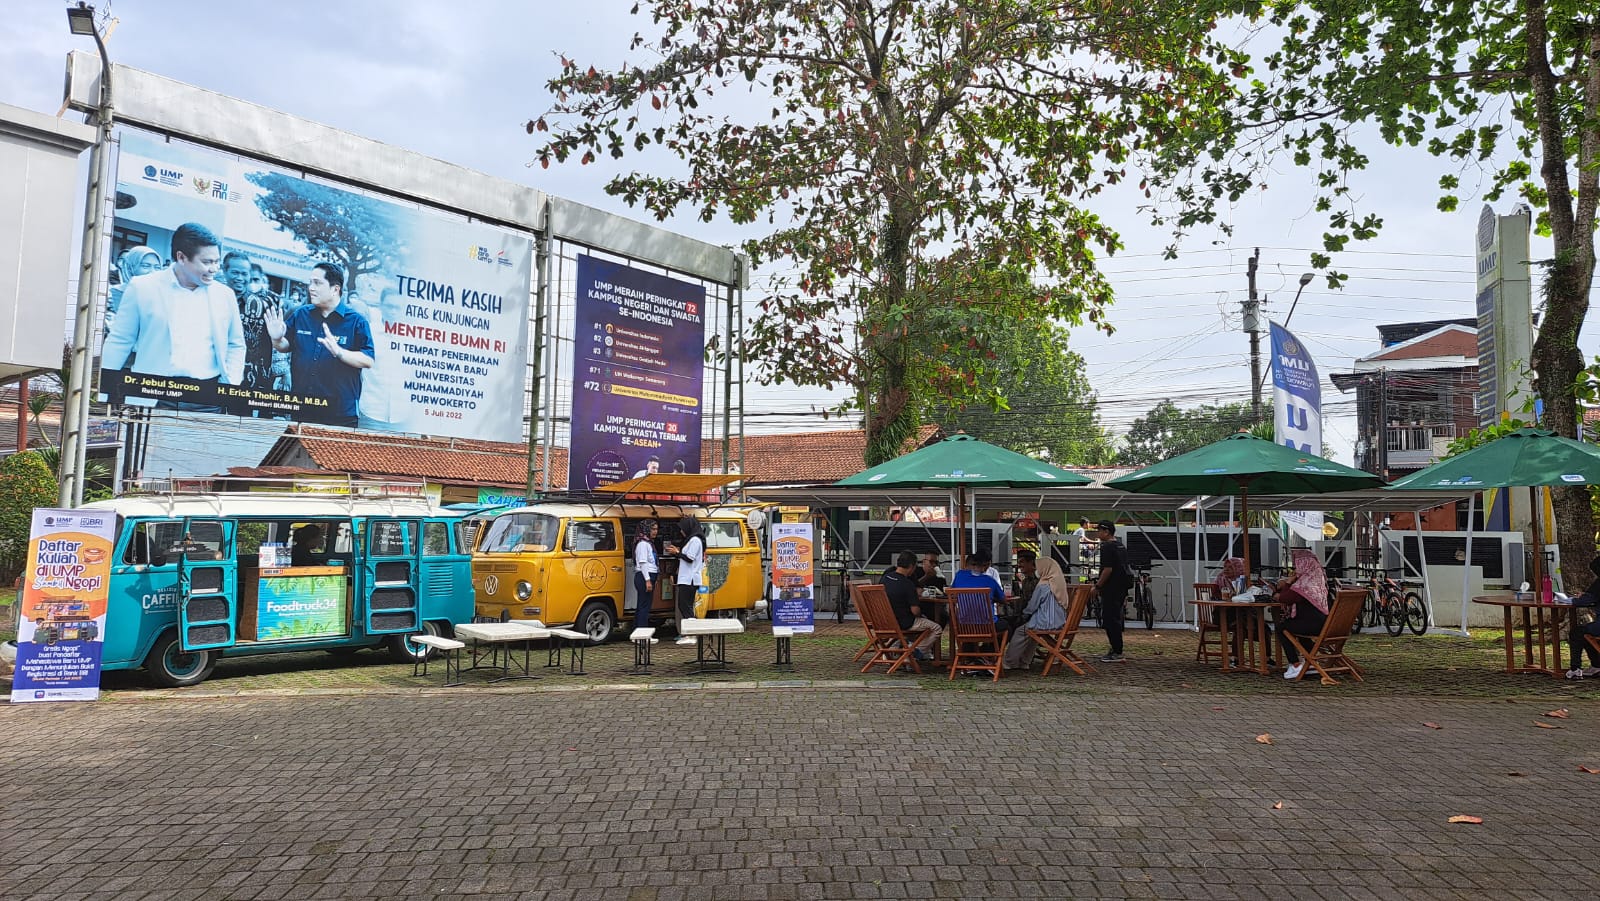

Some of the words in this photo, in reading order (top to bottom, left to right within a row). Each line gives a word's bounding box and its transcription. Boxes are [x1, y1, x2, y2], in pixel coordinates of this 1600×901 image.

[160, 168, 184, 180] UMP
[1478, 251, 1497, 276] UMP
[396, 274, 455, 306] TERIMA
[461, 288, 502, 314] KASIH
[594, 279, 613, 291] UMP
[614, 285, 644, 300] MERAIH
[645, 292, 686, 310] PERINGKAT
[687, 302, 696, 313] 72
[588, 289, 622, 305] KAMPUS
[624, 297, 652, 312] NEGERI
[653, 305, 669, 316] DAN
[671, 308, 700, 323] SWASTA
[405, 304, 429, 320] ATAS
[432, 310, 490, 331] KUNJUNGAN
[619, 306, 674, 327] SE-INDONESIA
[594, 322, 602, 330] #1
[384, 320, 446, 343] MENTERI
[450, 332, 490, 350] BUMN
[494, 340, 506, 353] RI
[390, 341, 400, 351] DI
[403, 343, 439, 357] TEMPAT
[441, 349, 499, 366] PENERIMAAN
[401, 356, 461, 373] MAHASISWA
[463, 364, 488, 377] BARU
[589, 366, 601, 375] #71
[124, 375, 139, 385] Dr.
[140, 378, 166, 388] Jebul
[168, 380, 200, 392] Suroso
[415, 369, 475, 386] UNIVERSITAS
[584, 381, 600, 391] #72
[141, 387, 165, 396] Rektor
[166, 389, 183, 398] UMP
[217, 387, 227, 395] H.
[229, 388, 251, 399] Erick
[253, 390, 282, 402] Thohir,
[304, 396, 328, 407] M.B.A
[404, 380, 484, 399] MUHAMMADIYAH
[248, 399, 272, 408] Menteri
[273, 402, 293, 410] BUMN
[410, 393, 476, 410] PURWOKERTO
[424, 408, 430, 416] 5
[431, 409, 445, 418] Juli
[446, 411, 463, 420] 2022
[606, 415, 624, 424] UMP
[625, 417, 665, 431] PERINGKAT
[668, 423, 677, 432] 20
[594, 423, 626, 435] KAMPUS
[628, 427, 657, 439] SWASTA
[659, 431, 688, 443] TERBAIK
[621, 436, 662, 449] SE-ASEAN+
[89, 518, 103, 526] BRI
[39, 539, 82, 552] Daftar
[38, 552, 77, 564] Kuliah
[36, 565, 48, 576] di
[52, 565, 84, 577] UMP
[65, 576, 101, 591] Ngopi
[266, 598, 337, 613] Foodtruck34
